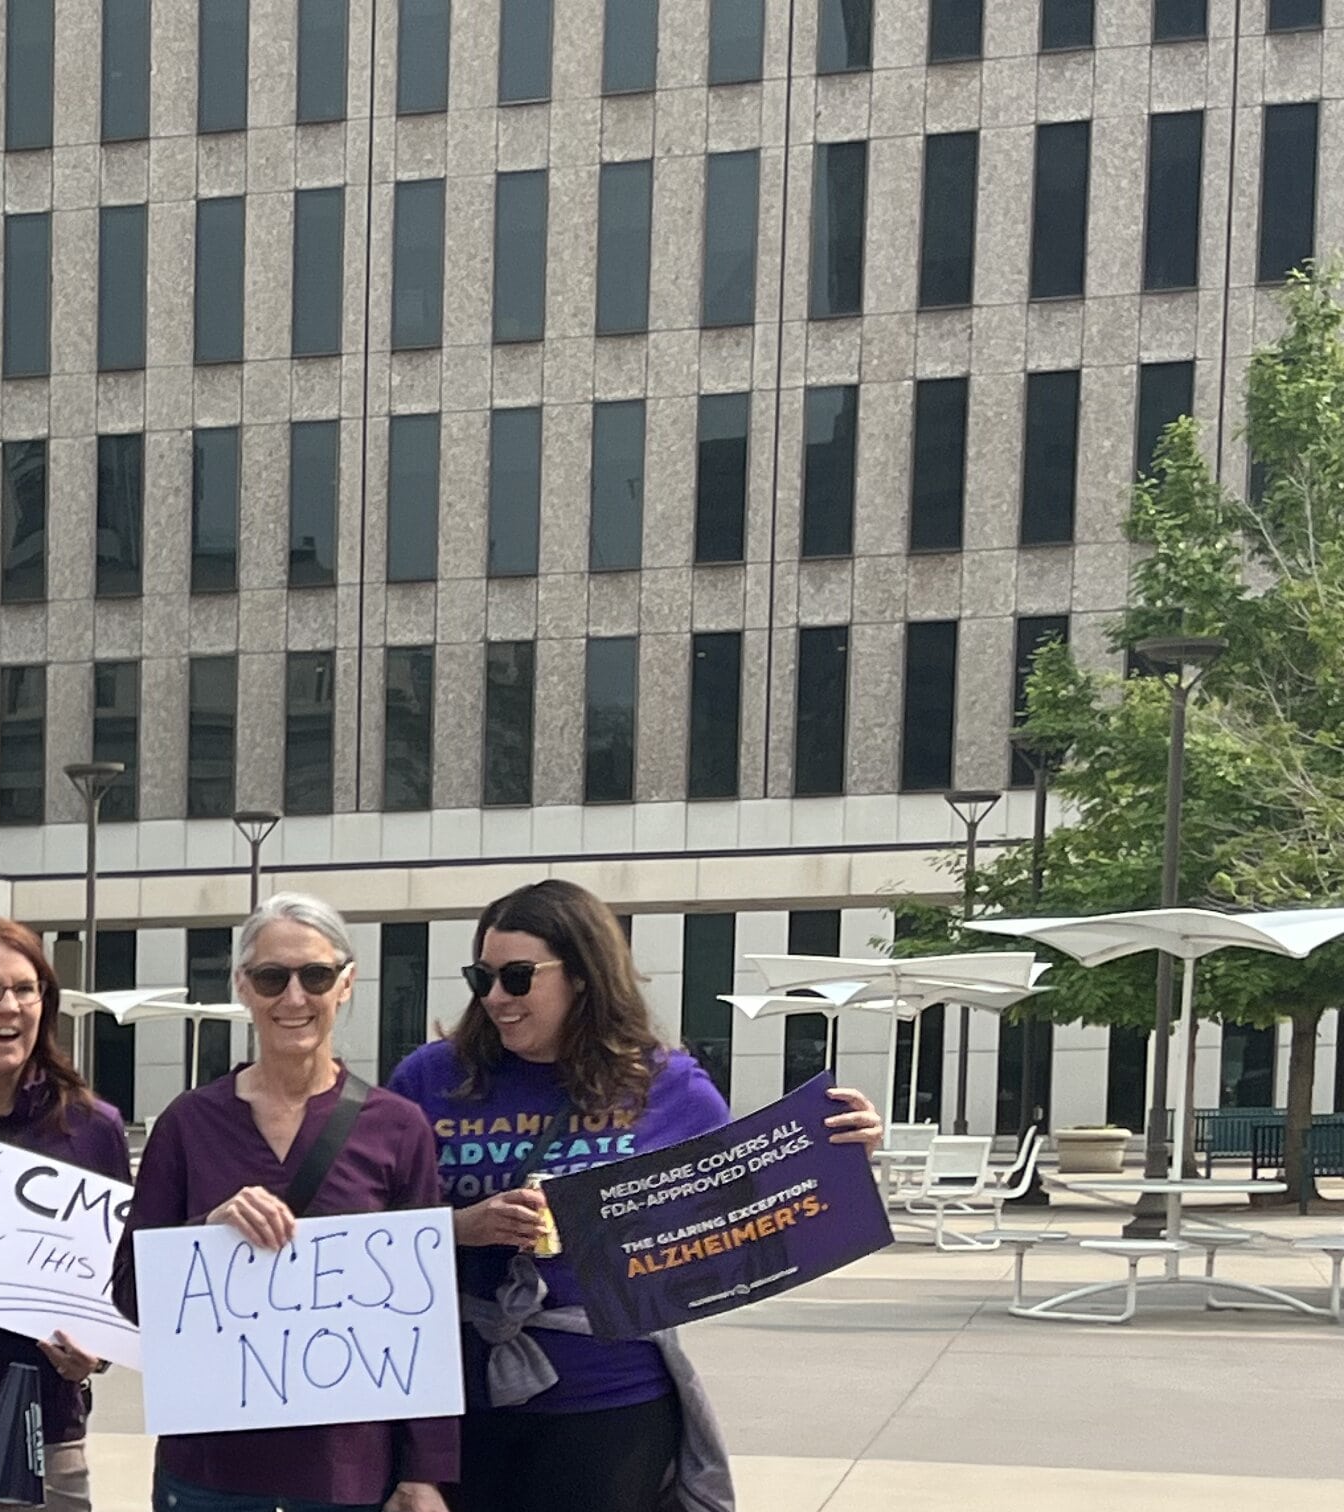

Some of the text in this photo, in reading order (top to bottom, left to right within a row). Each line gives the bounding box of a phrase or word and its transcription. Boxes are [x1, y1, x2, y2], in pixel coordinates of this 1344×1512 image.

[599, 1163, 697, 1202] MEDICARE
[696, 1134, 771, 1173] COVERS
[771, 1120, 804, 1144] ALL
[599, 1164, 747, 1220] FDA-APPROVED
[747, 1134, 814, 1173] DRUGS.
[16, 1228, 96, 1280] THIS
[620, 1178, 819, 1255] THE GLARING EXCEPTION:
[626, 1194, 831, 1280] ALZHEIMER'S.
[175, 1226, 442, 1335] ACCESS
[239, 1325, 421, 1408] NOW
